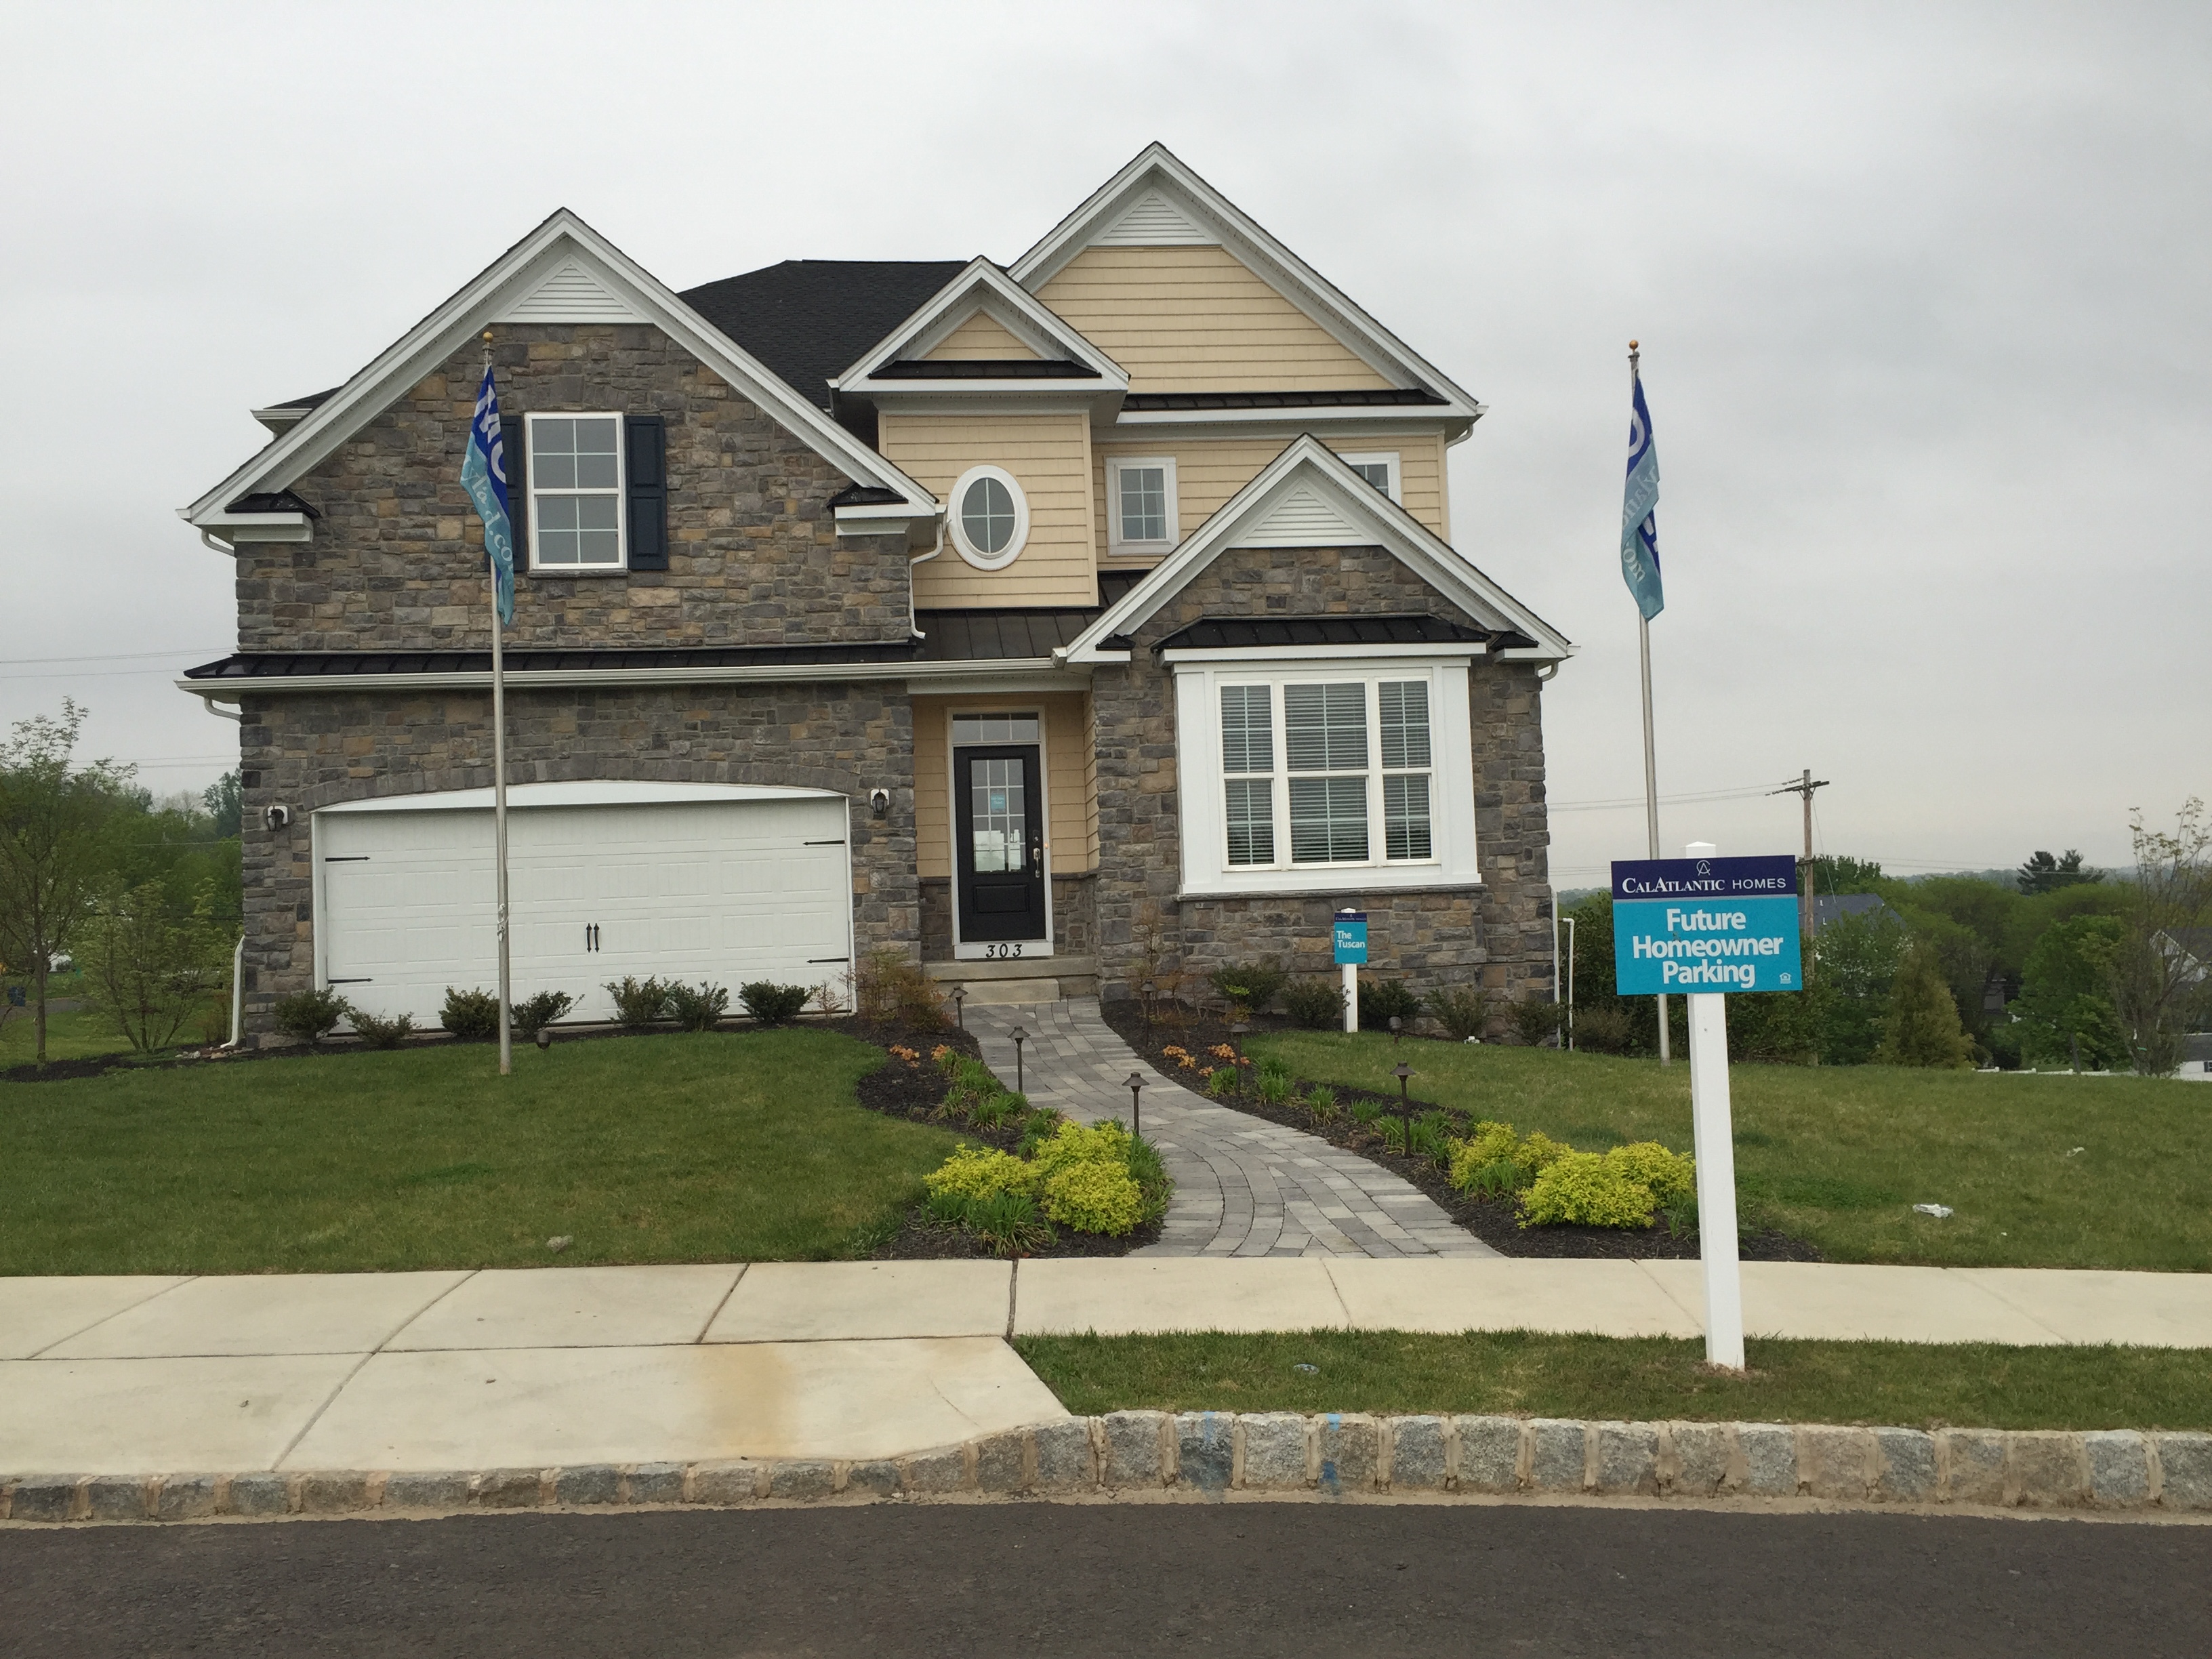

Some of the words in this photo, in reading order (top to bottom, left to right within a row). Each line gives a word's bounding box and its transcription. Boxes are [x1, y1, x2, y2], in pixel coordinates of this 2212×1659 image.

[1622, 877, 1725, 893] CALATLANTIC
[1732, 878, 1786, 890] HOMES
[1666, 908, 1746, 931] Future
[1336, 930, 1352, 939] The
[985, 943, 1023, 958] 303
[1337, 939, 1366, 948] Tuscan
[1633, 935, 1784, 959] Homeowner
[1662, 958, 1755, 989] Parking
